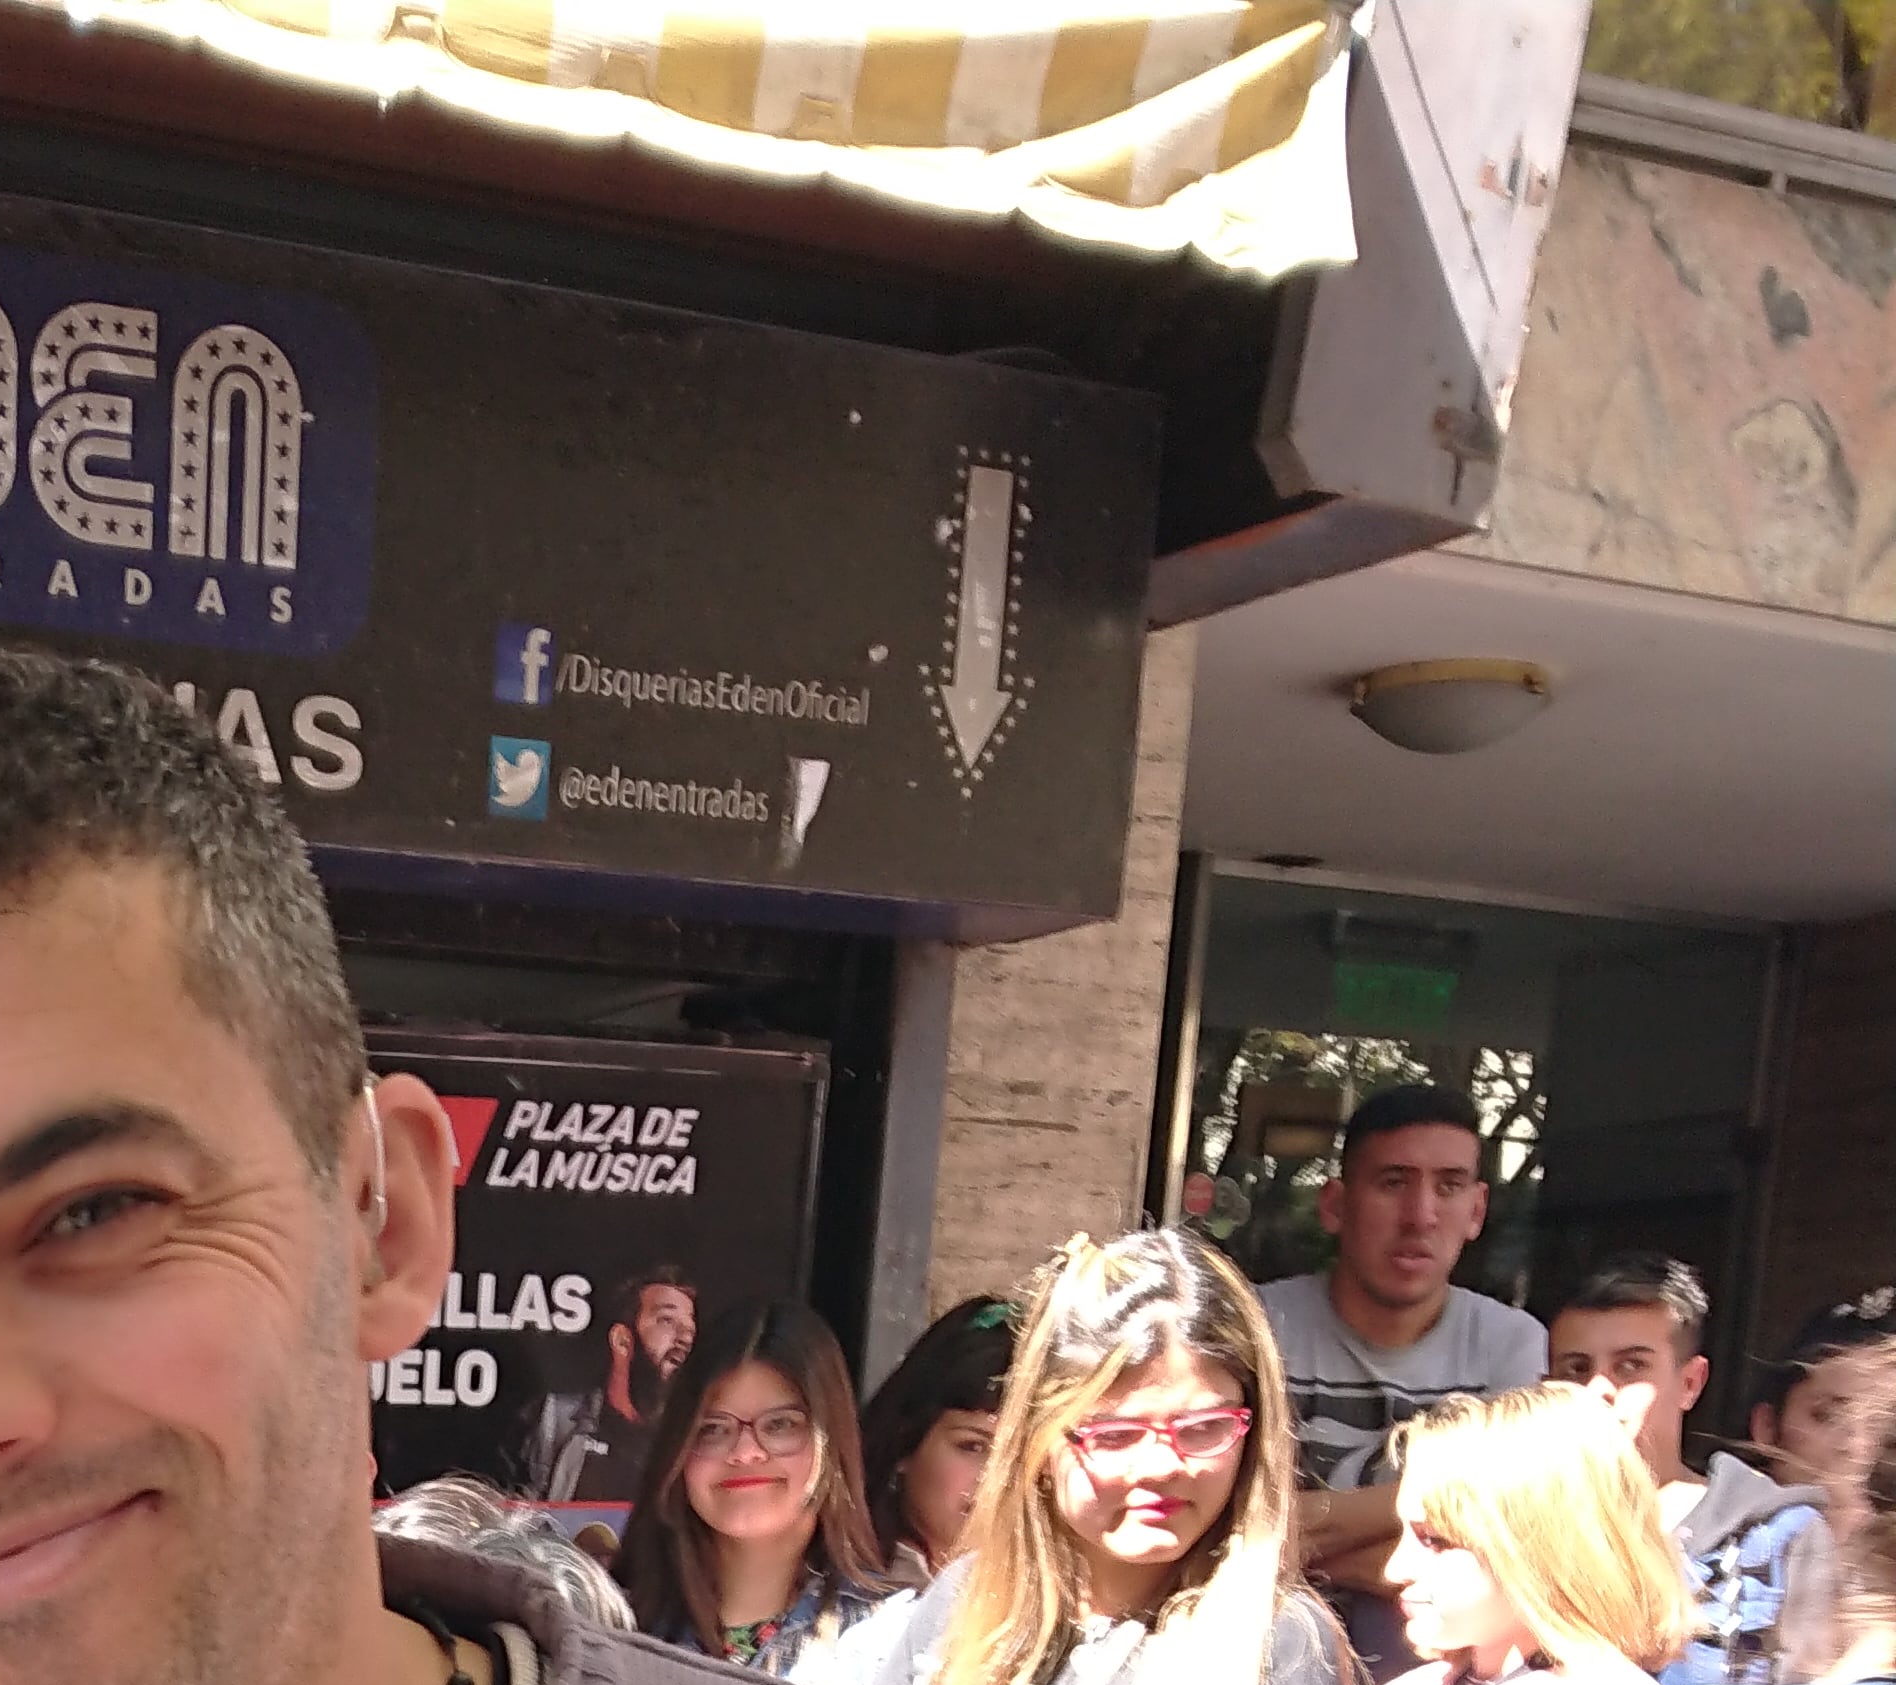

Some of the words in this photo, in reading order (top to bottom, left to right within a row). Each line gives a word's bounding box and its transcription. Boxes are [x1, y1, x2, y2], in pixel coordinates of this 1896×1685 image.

[558, 763, 770, 823] @edenentradas
[503, 1100, 635, 1145] PLAZA
[637, 1106, 701, 1148] DE
[485, 1147, 540, 1189] LA
[541, 1143, 697, 1195] MÚSICA
